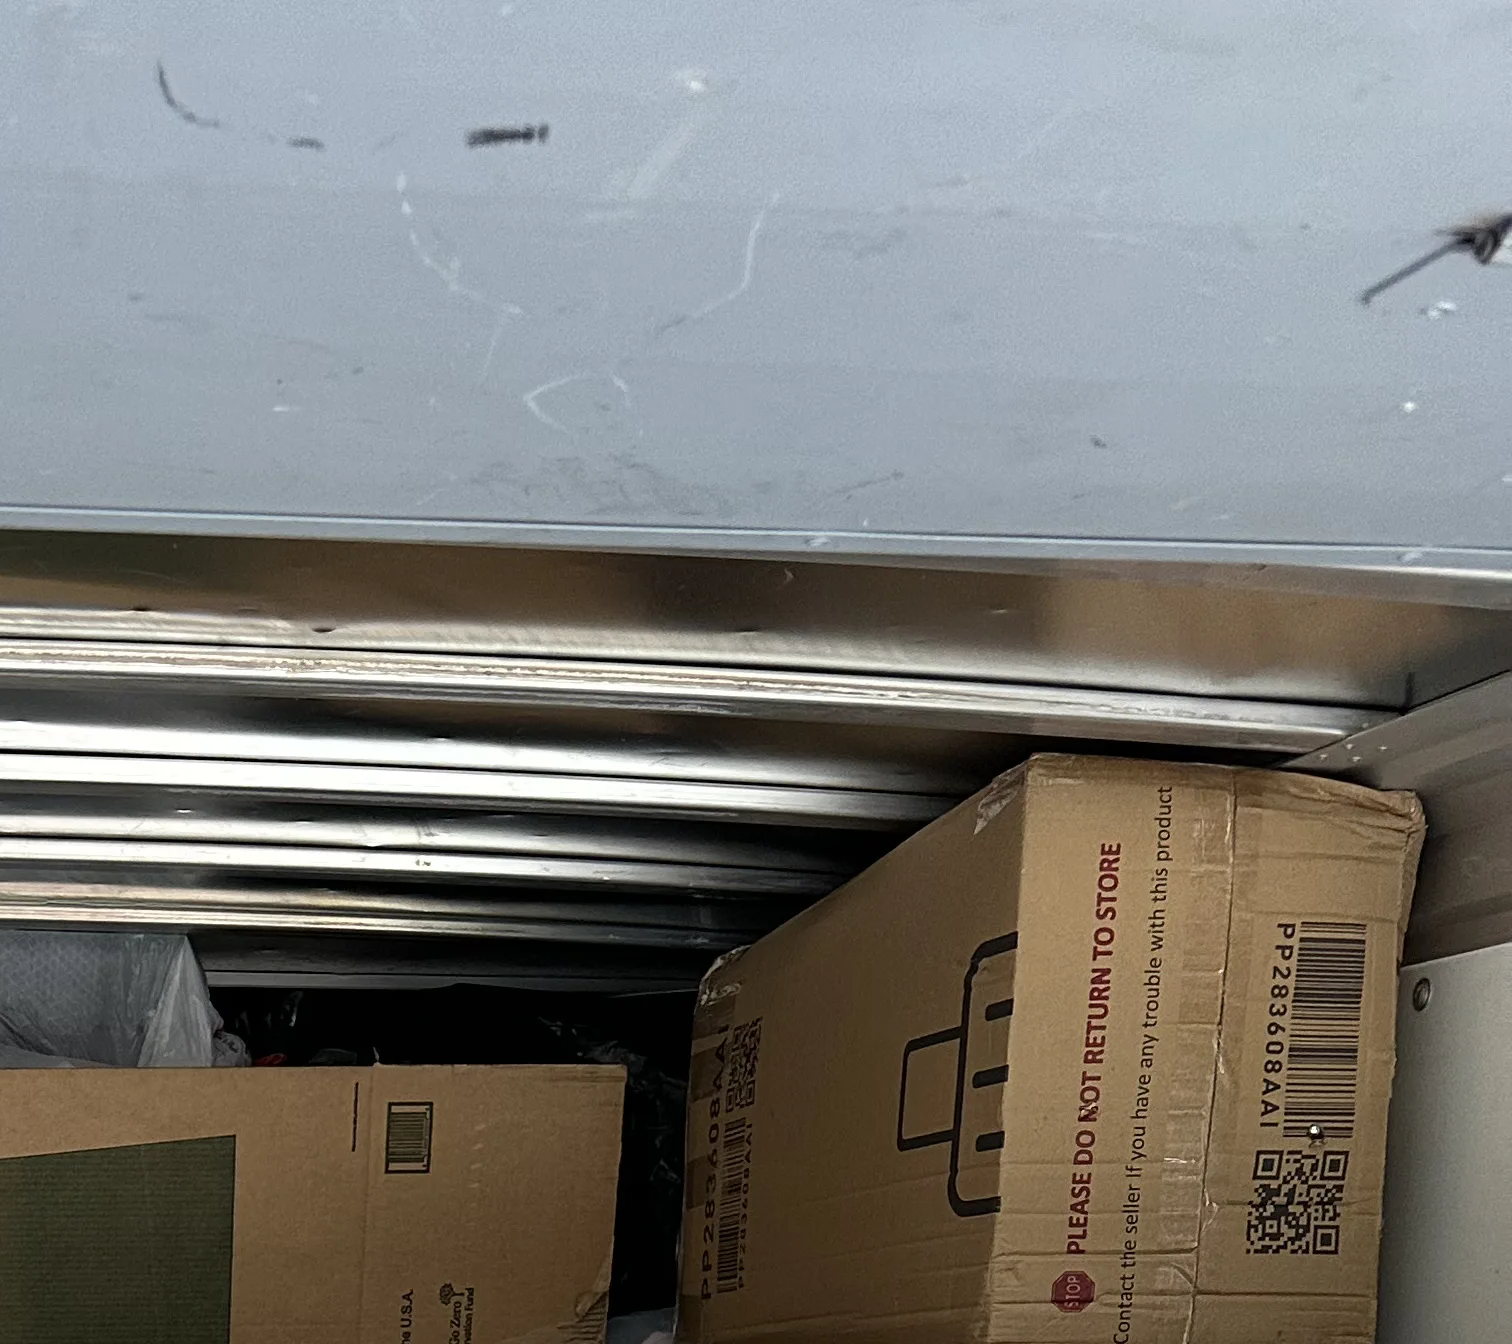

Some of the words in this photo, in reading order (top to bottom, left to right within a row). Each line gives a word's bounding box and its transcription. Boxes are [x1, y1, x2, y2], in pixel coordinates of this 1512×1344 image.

[1154, 786, 1173, 862] product
[1095, 843, 1121, 921] STORE
[1150, 867, 1168, 903] this
[1092, 926, 1115, 961] TO
[1148, 909, 1165, 951] with
[1144, 957, 1162, 1028] trouble
[1083, 968, 1112, 1064] RETURN
[1259, 922, 1296, 1129] PP283608AAI
[1140, 1034, 1159, 1068] any
[1078, 1071, 1102, 1122] NOT
[1131, 1075, 1151, 1120] have
[1073, 1130, 1096, 1166] DO
[1131, 1126, 1148, 1162] you
[1126, 1163, 1142, 1178] If
[1067, 1172, 1092, 1254] PLEASE
[1123, 1184, 1141, 1235] seller
[1121, 1238, 1137, 1268] the
[464, 1288, 475, 1311] Fund
[1064, 1275, 1081, 1308] STOP
[1113, 1274, 1135, 1344] Contact
[450, 1301, 462, 1328] Zero
